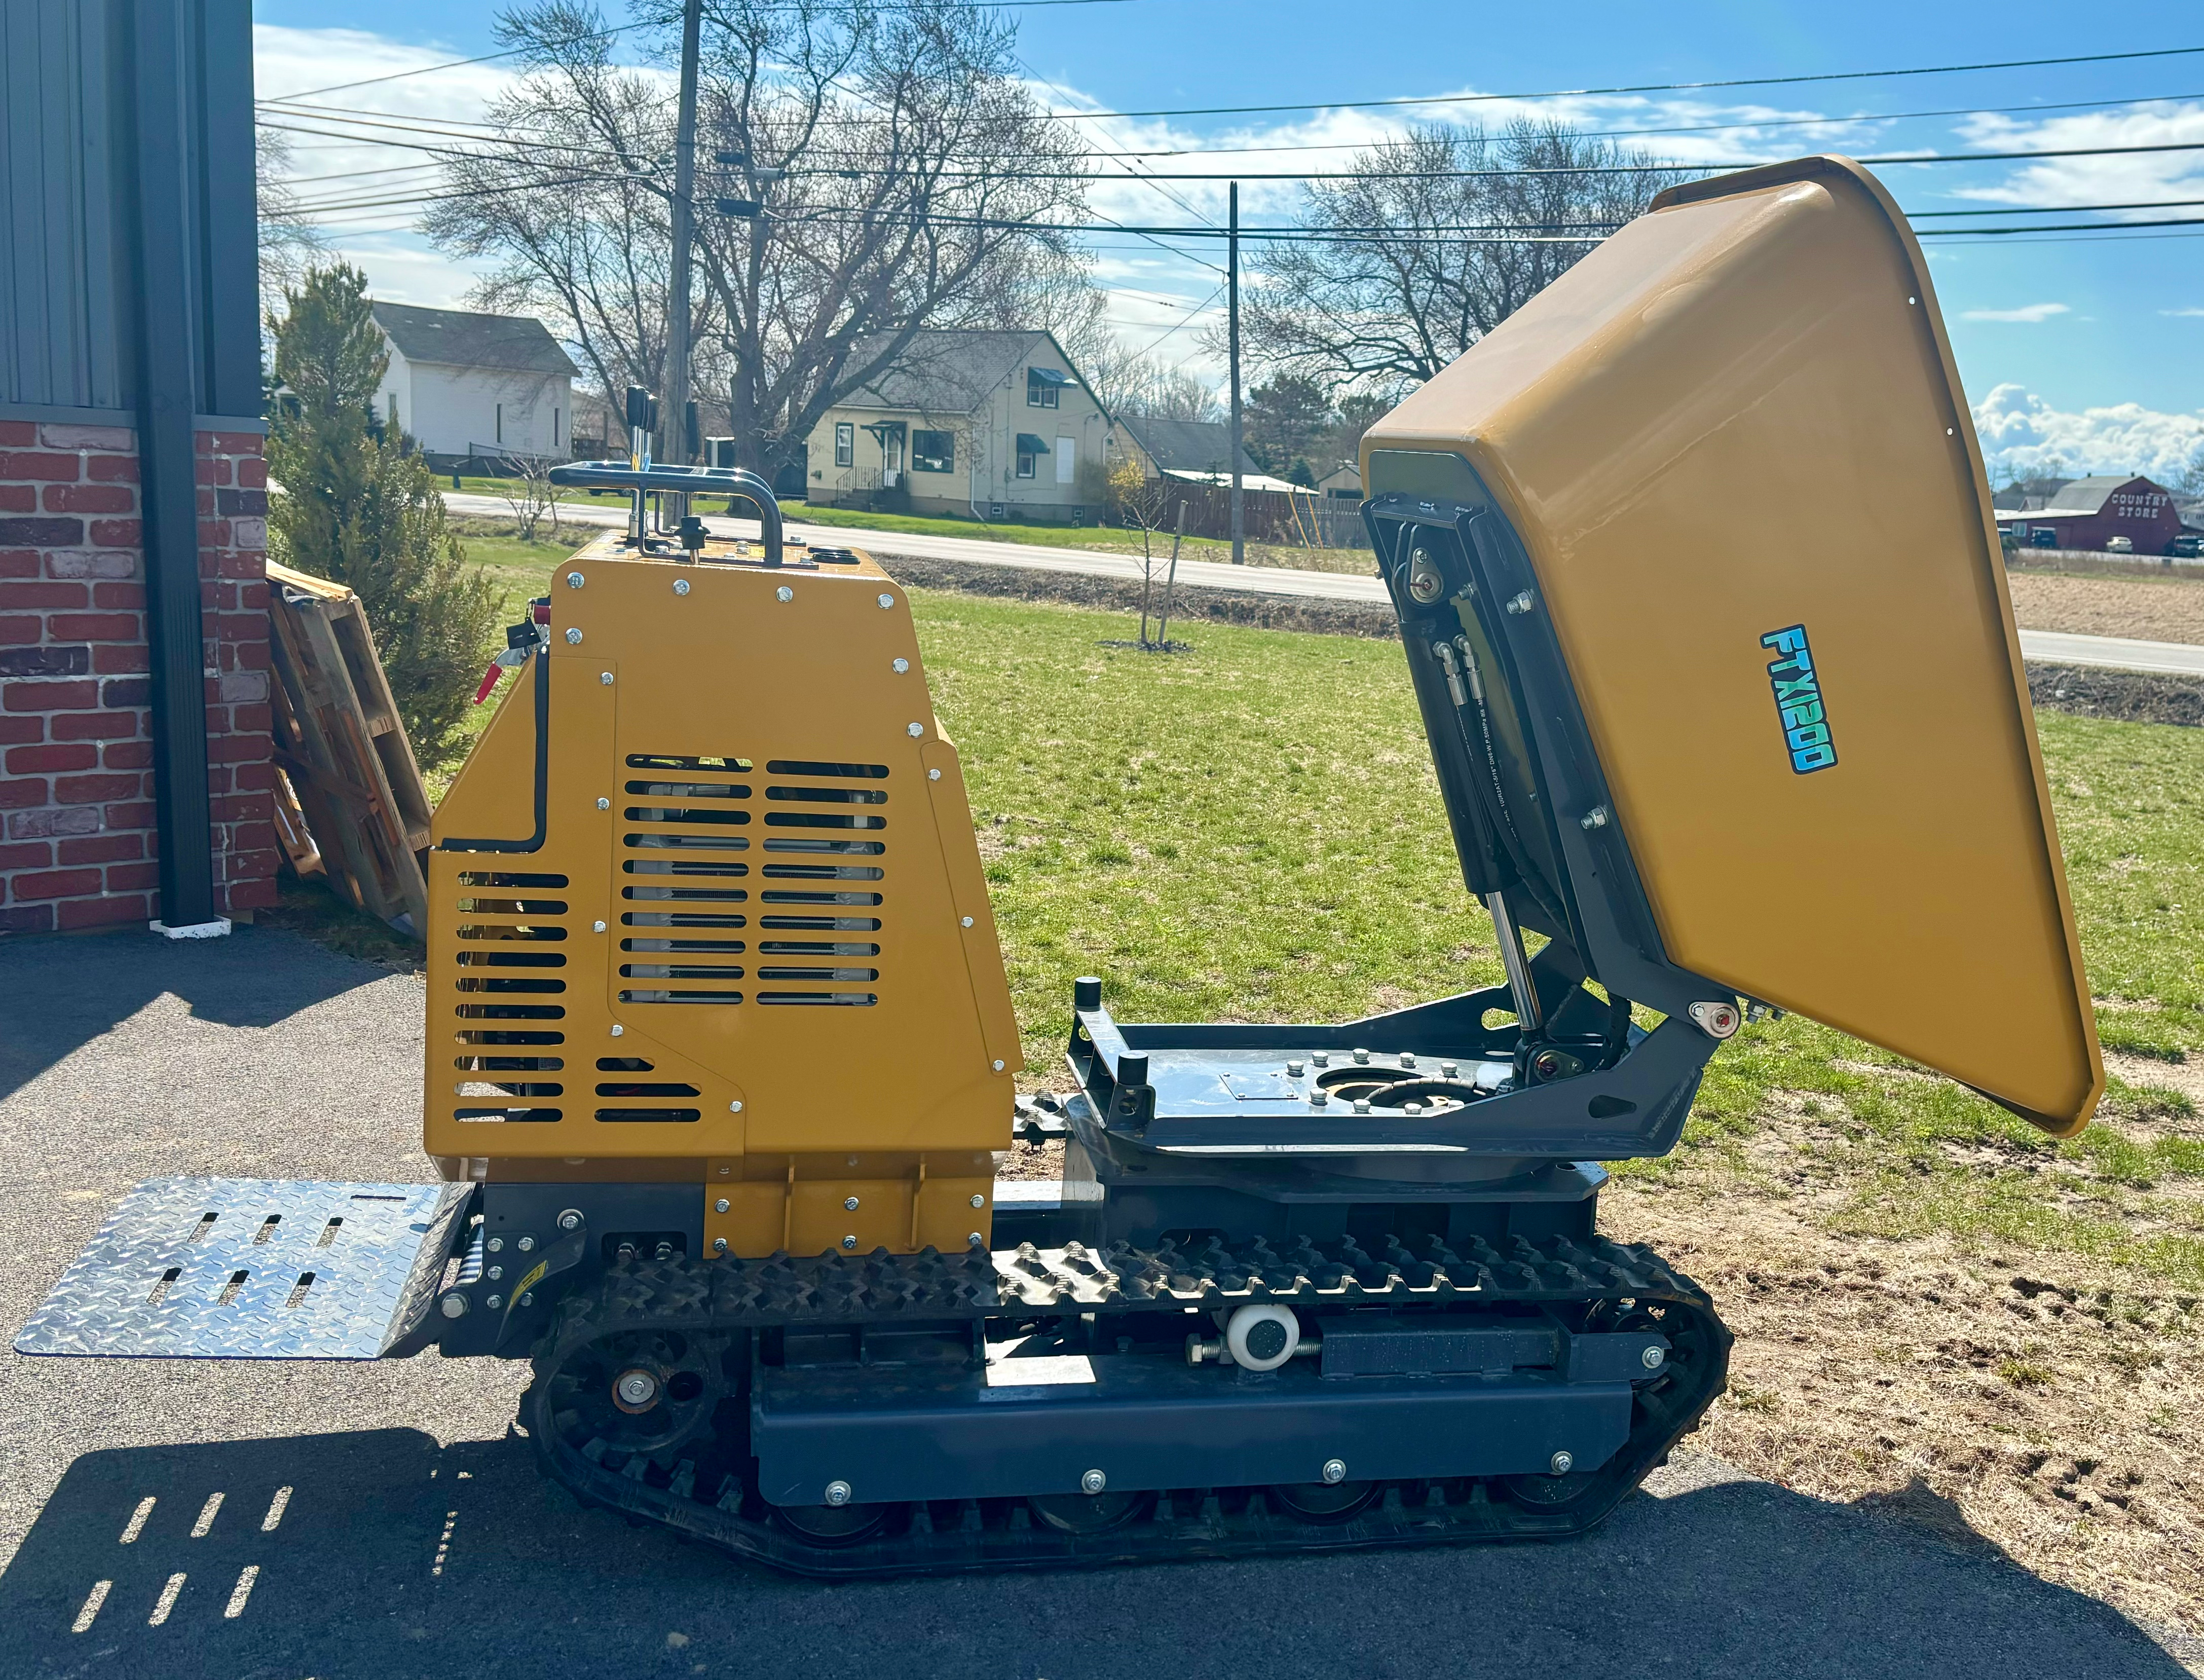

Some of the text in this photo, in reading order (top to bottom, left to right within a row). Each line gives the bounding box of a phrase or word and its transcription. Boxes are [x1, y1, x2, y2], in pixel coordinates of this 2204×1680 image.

[2112, 494, 2168, 507] COUNTRY
[2118, 506, 2158, 518] STORE
[1763, 627, 1836, 771] FTX1200
